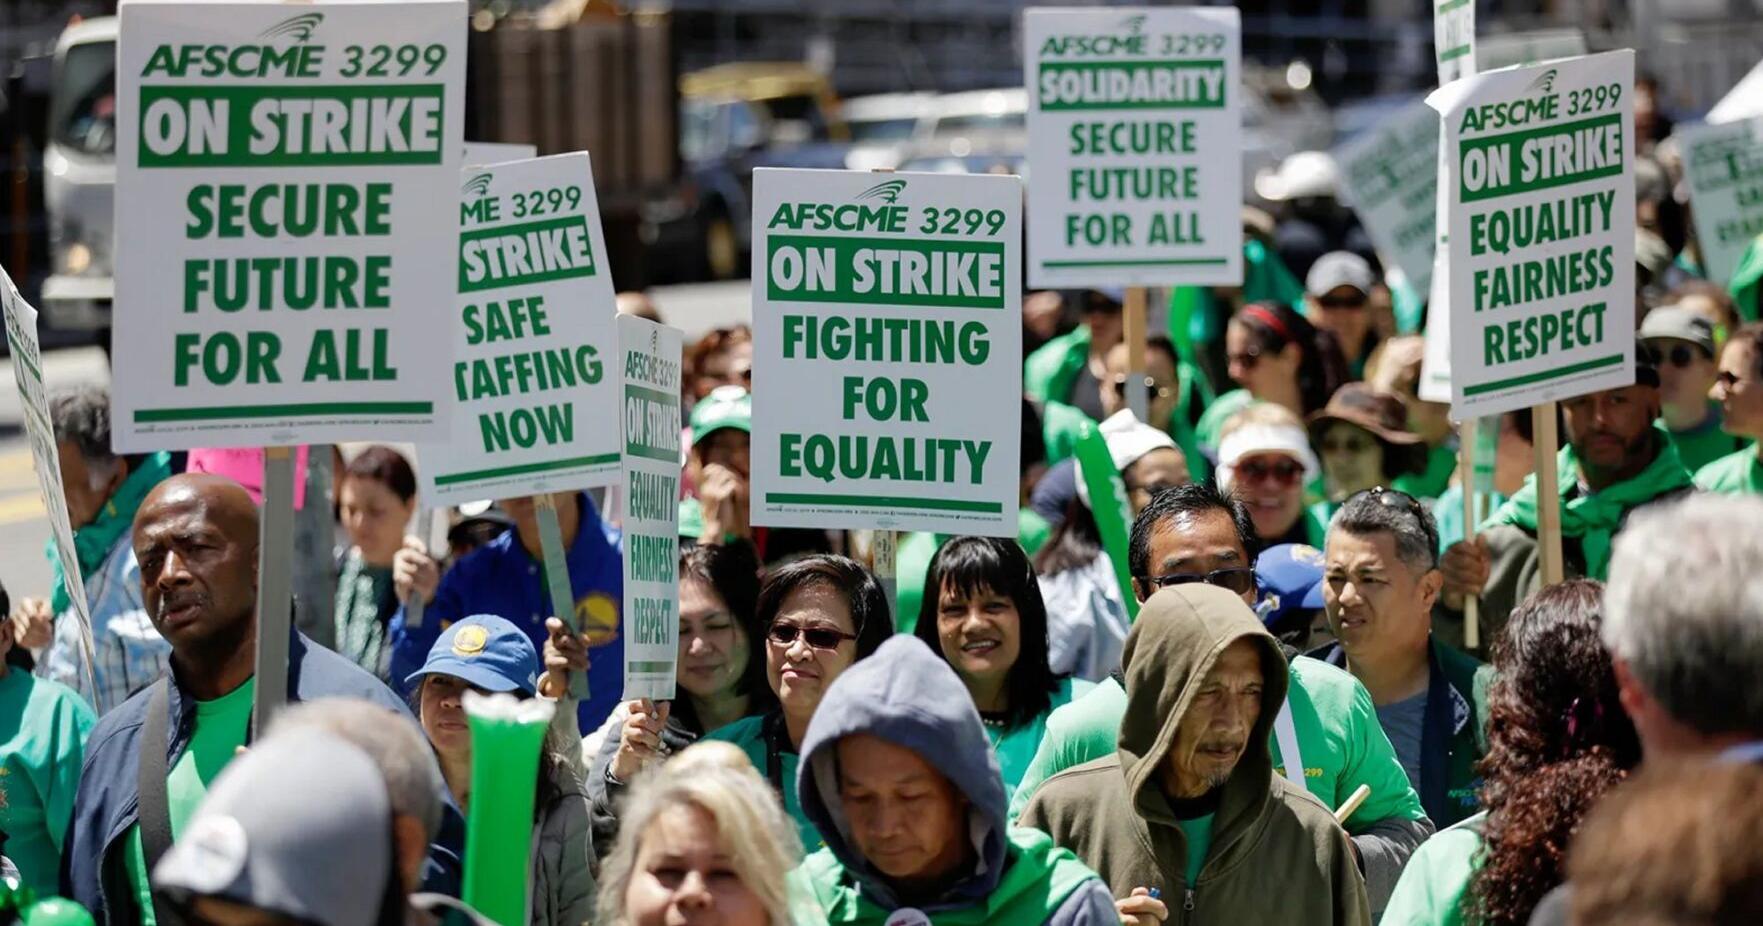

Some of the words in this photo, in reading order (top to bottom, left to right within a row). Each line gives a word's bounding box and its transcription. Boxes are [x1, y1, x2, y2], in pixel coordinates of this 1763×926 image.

[140, 44, 326, 78] AFSCME
[339, 43, 447, 78] 3299
[1040, 35, 1148, 55] AFSCME
[1161, 33, 1225, 54] 3299
[1041, 68, 1222, 104] SOLIDARITY
[1459, 94, 1559, 134] AFSCME
[1567, 83, 1622, 116] 3299
[143, 97, 230, 156] ON
[250, 97, 440, 156] STRIKE
[1070, 121, 1197, 154] SECURE
[1463, 143, 1511, 192] ON
[1521, 122, 1621, 183] STRIKE
[512, 186, 581, 217] 3299
[1070, 166, 1198, 200] FUTURE
[185, 183, 393, 239] SECURE
[767, 202, 909, 232] AFSCME
[919, 207, 1006, 236] 3299
[1066, 213, 1132, 246] FOR
[1147, 212, 1204, 244] ALL
[1470, 189, 1615, 256] EQUALITY
[462, 224, 591, 283] STRIKE
[771, 245, 836, 292] ON
[852, 248, 1001, 297] STRIKE
[1474, 245, 1614, 312] FAIRNESS
[183, 256, 391, 313] FUTURE
[462, 296, 550, 345] SAFE
[783, 315, 990, 365] FIGHTING
[1484, 302, 1606, 367] RESPECT
[174, 331, 282, 386] FOR
[303, 328, 397, 382] ALL
[455, 345, 603, 402] TAFFING
[625, 350, 657, 384] AFSCME
[627, 396, 644, 446] ON
[646, 399, 678, 452] STRIKE
[843, 376, 930, 422] FOR
[479, 402, 573, 453] NOW
[780, 433, 992, 484] EQUALITY
[630, 470, 676, 522] EQUALITY
[631, 534, 673, 583] FAIRNESS
[634, 598, 671, 645] RESPECT
